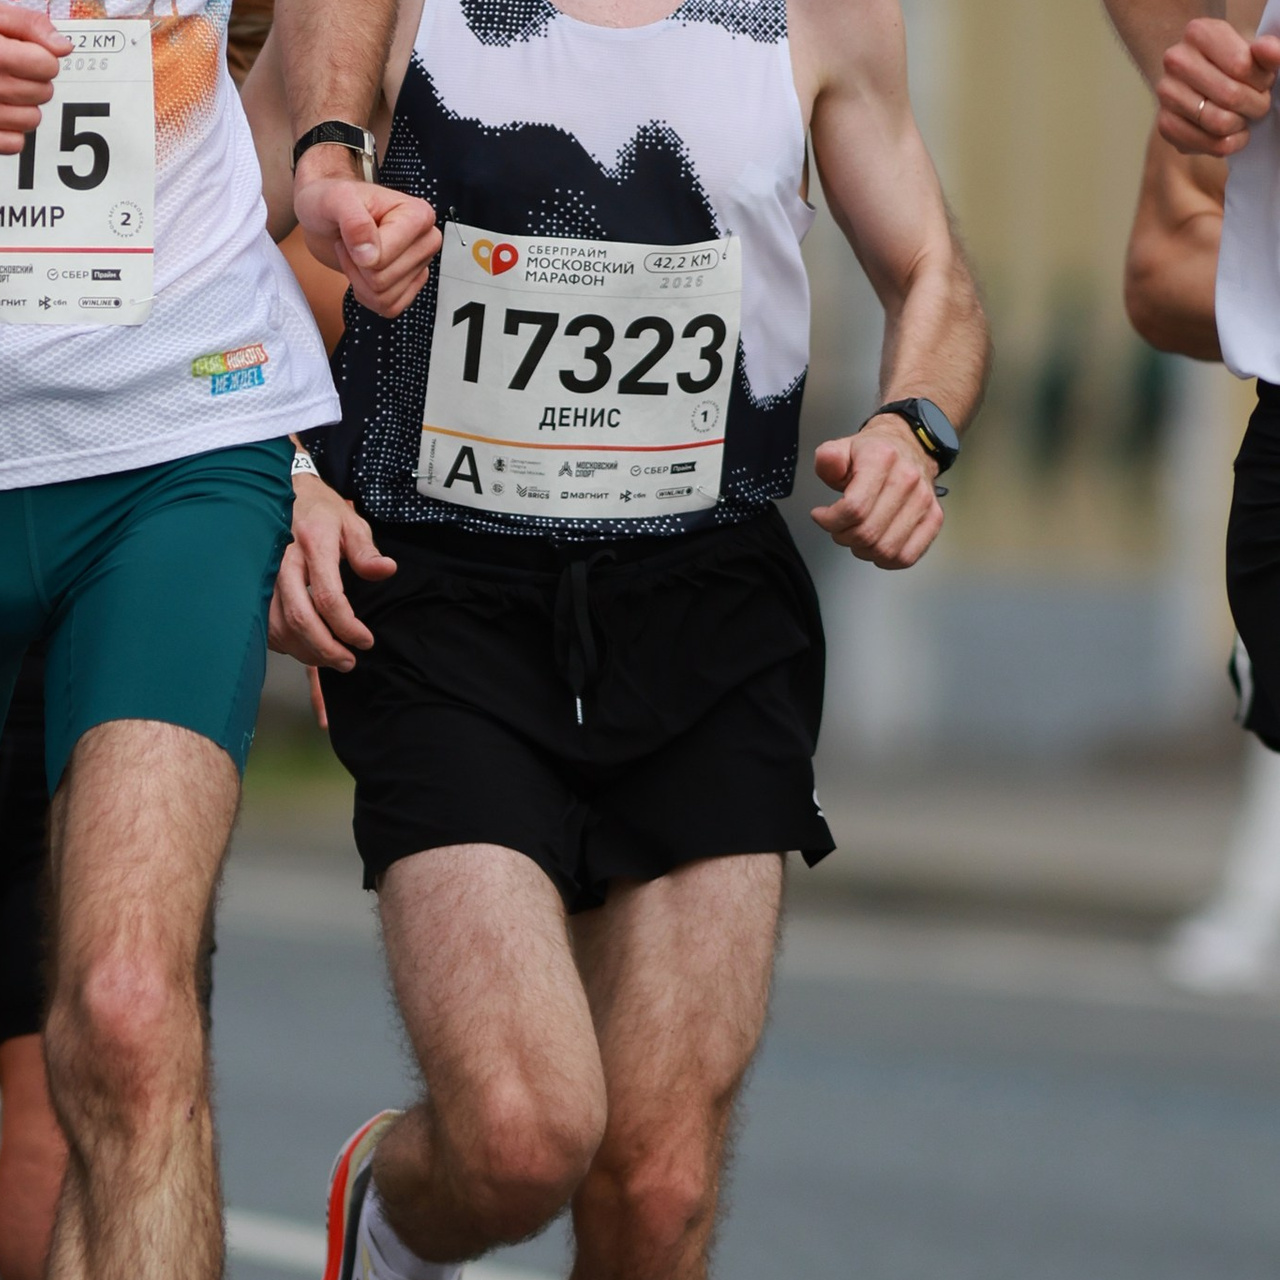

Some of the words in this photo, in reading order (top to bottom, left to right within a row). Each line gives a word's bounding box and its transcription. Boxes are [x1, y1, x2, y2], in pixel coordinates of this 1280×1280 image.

[62, 57, 109, 71] 2026
[120, 212, 131, 226] 2
[528, 244, 607, 259] СБЕРПРАЙМ
[526, 256, 635, 275] МОСКОВСКИЙ
[653, 256, 686, 270] 42,2
[61, 271, 89, 279] СБЕР
[93, 271, 117, 280] Прайм
[525, 271, 605, 287] МАРАФОН
[659, 275, 705, 289] 2026
[53, 299, 68, 307] сбп
[81, 299, 113, 307] WINLINE
[451, 300, 727, 396] 17323
[538, 406, 622, 431] ДЕНИС
[701, 410, 708, 422] 1
[575, 460, 619, 470] МОСКОВСКИЙ
[644, 465, 669, 475] СБЕР
[575, 470, 595, 478] СПОРТ
[527, 492, 550, 500] BRICS
[570, 492, 610, 500] магнит
[658, 488, 685, 497] WINLINE
